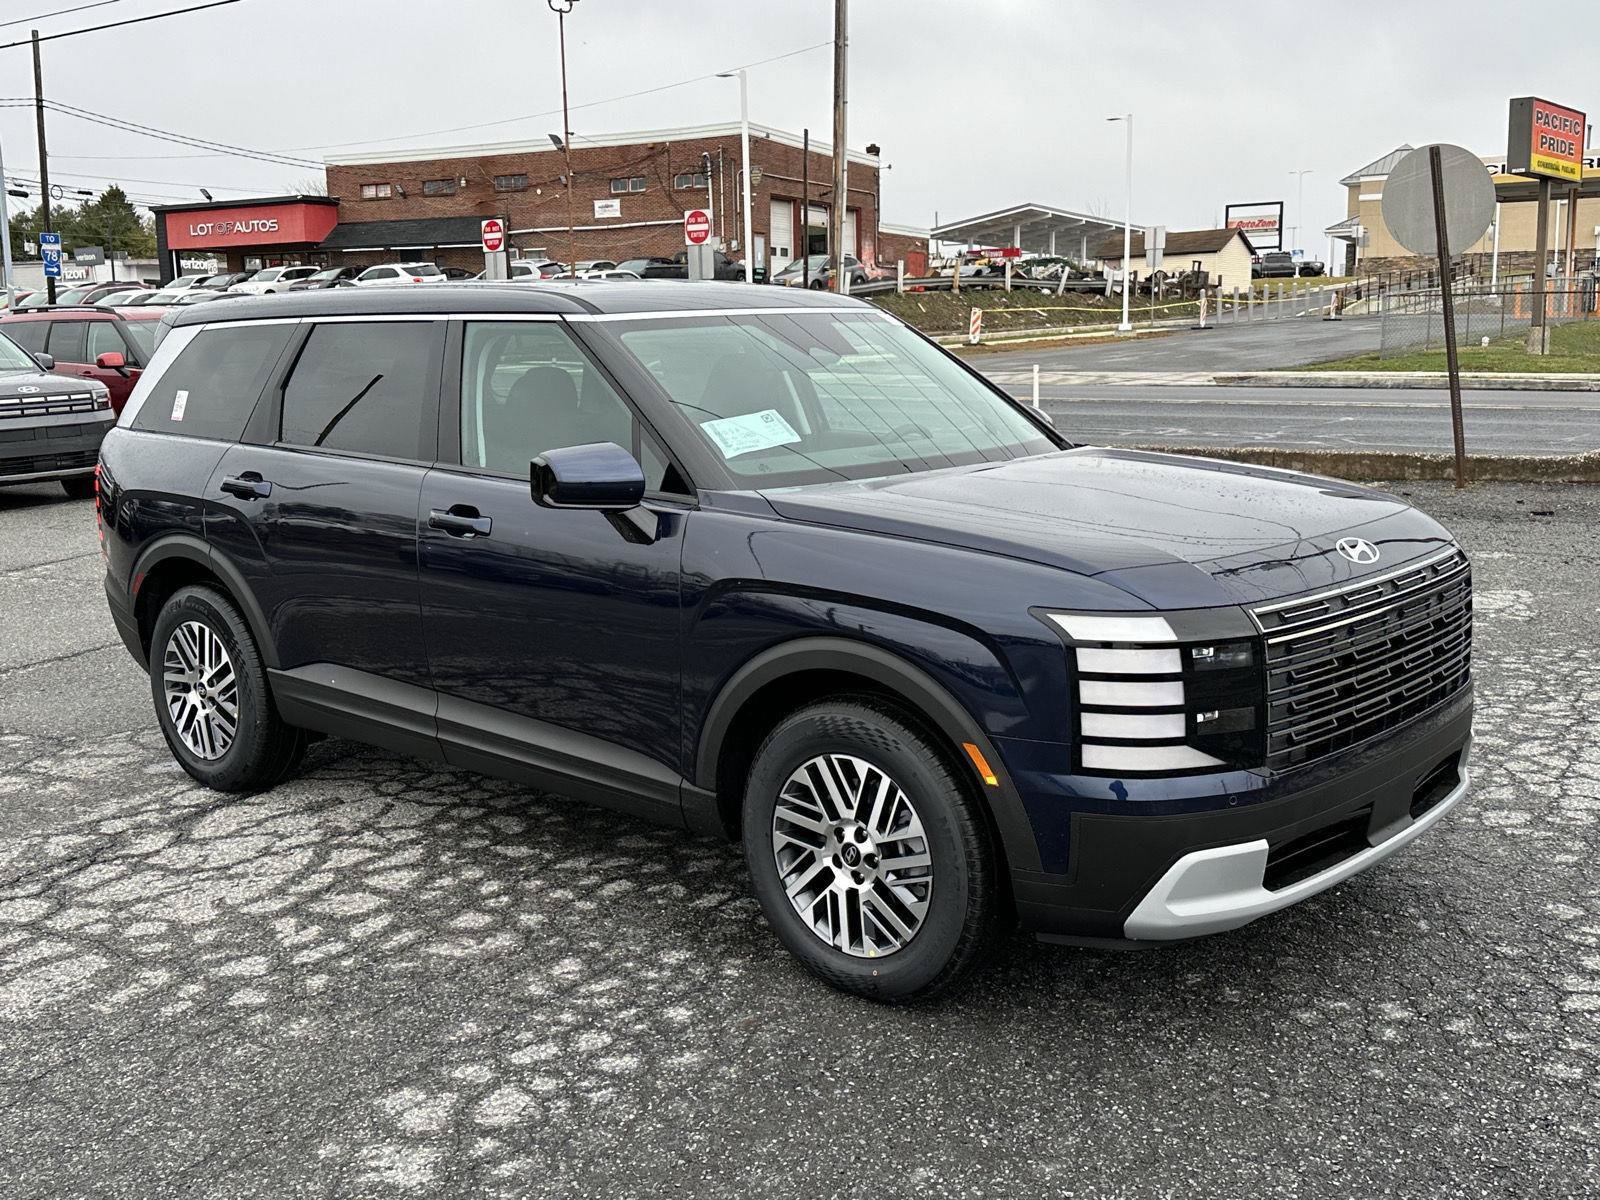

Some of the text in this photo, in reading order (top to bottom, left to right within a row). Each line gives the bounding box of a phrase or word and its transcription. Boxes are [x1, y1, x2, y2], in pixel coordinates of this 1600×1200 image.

[1536, 109, 1581, 136] PACIFIC
[1540, 134, 1575, 157] PRIDE
[190, 219, 279, 236] LOT OF AUTOS
[1236, 219, 1277, 228] AutoZone
[45, 251, 58, 261] 78
[180, 258, 208, 270] verizo
